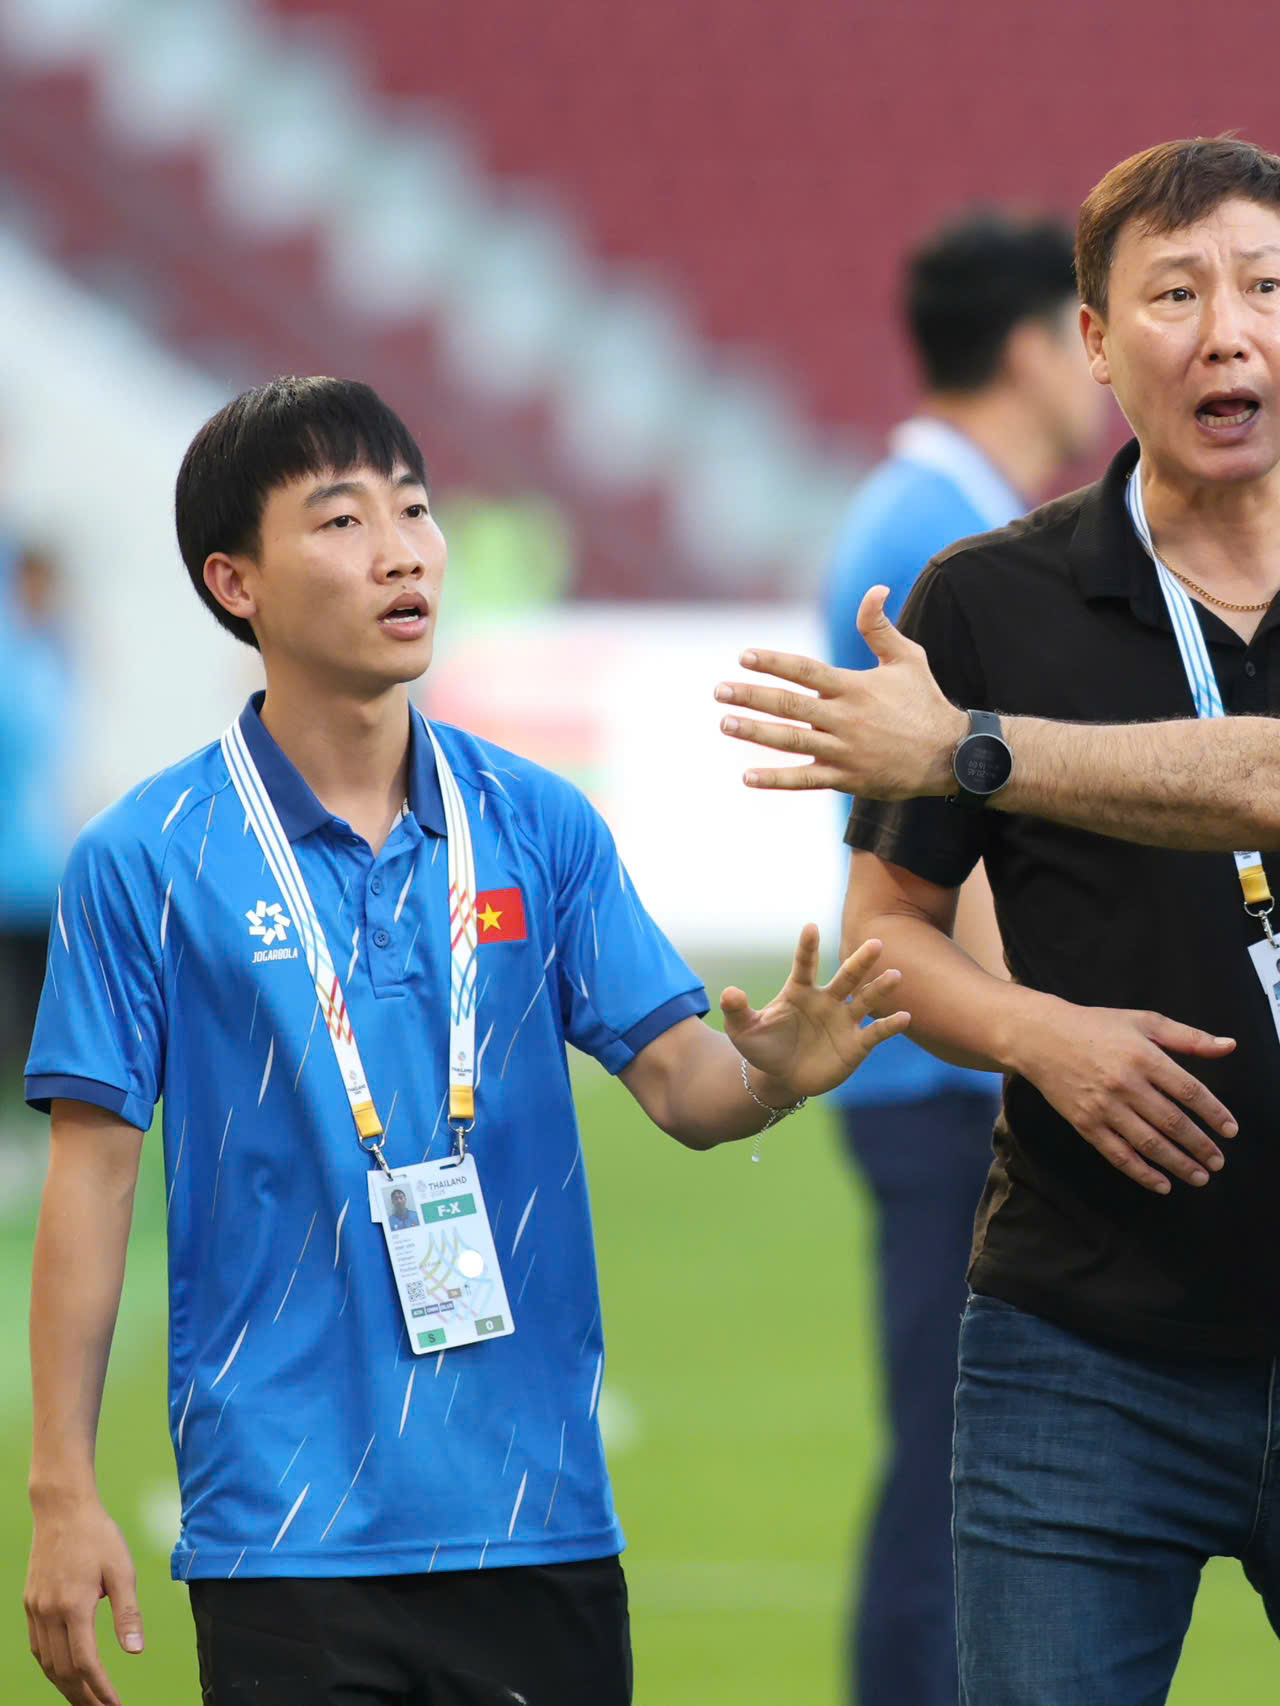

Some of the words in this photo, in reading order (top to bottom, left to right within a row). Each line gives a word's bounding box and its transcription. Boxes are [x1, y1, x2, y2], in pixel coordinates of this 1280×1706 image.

[252, 947, 298, 963] JOGARBOLA
[428, 1176, 467, 1190] THAILAND
[437, 1202, 461, 1217] F-X
[427, 1333, 436, 1344] S
